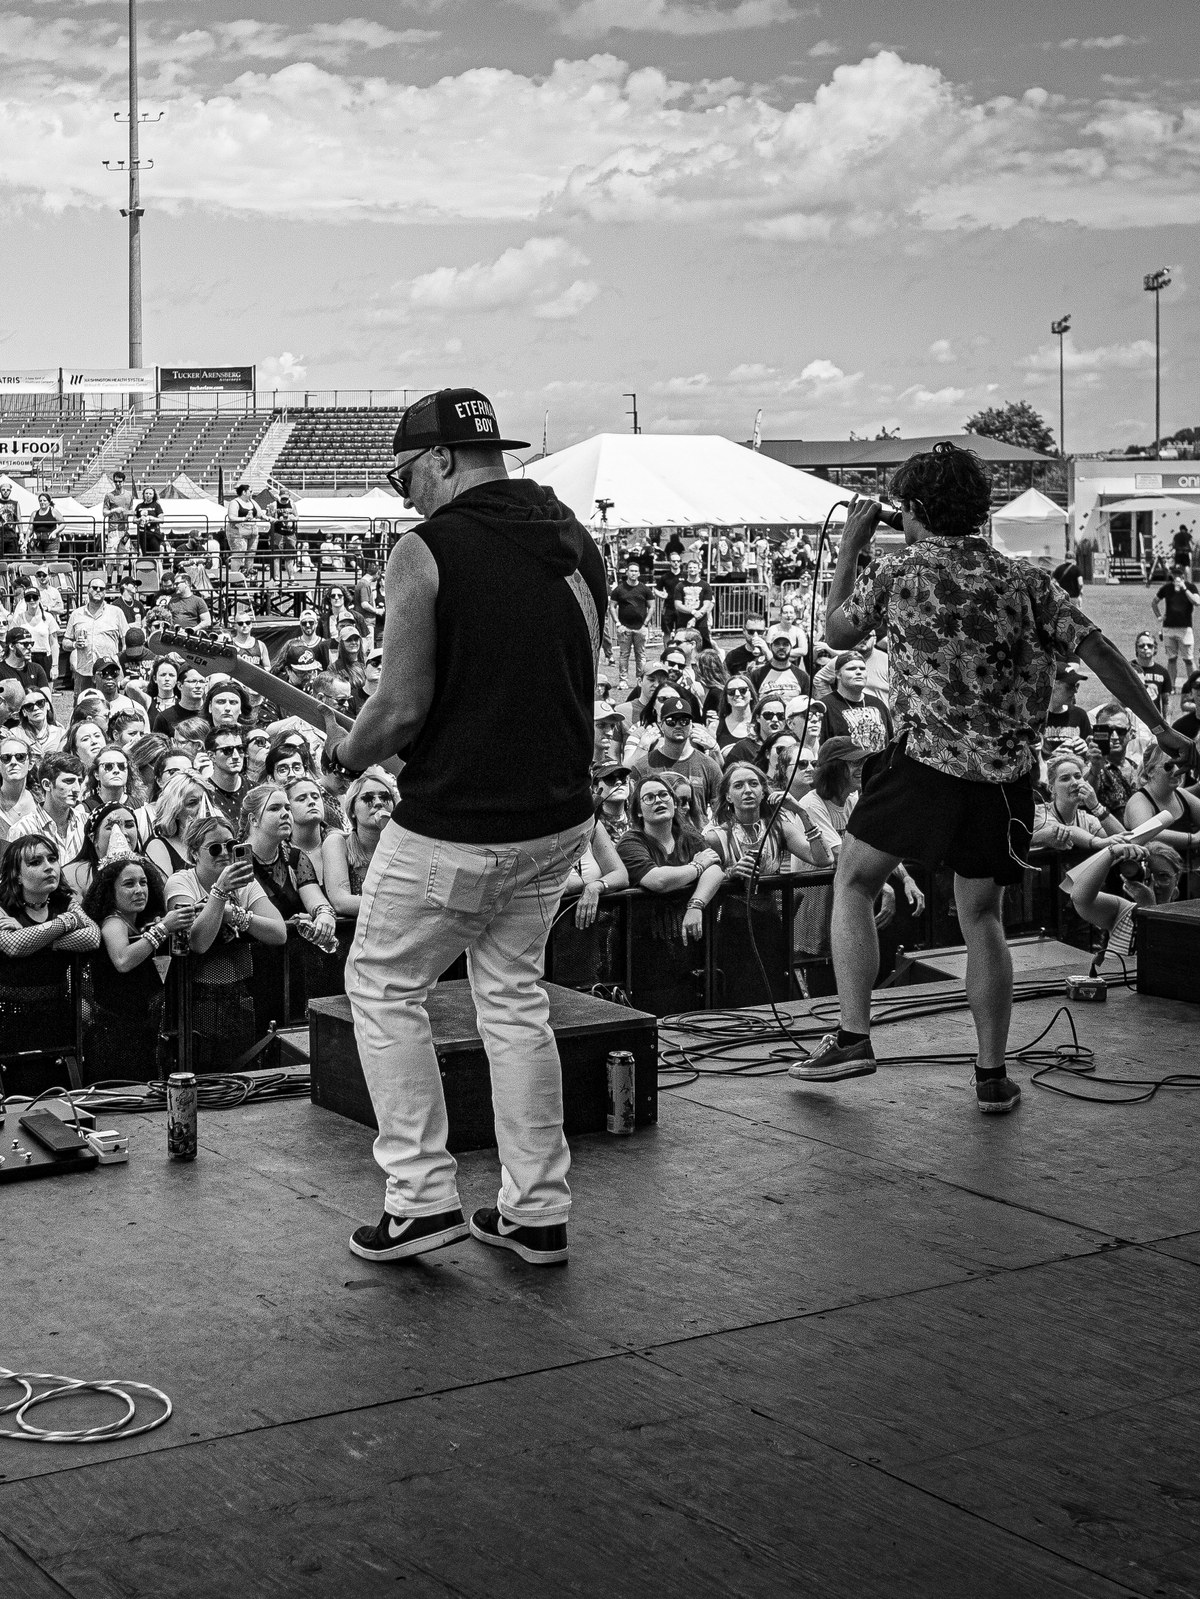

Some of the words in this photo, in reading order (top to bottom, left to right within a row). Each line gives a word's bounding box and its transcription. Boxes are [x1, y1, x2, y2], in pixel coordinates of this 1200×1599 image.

[172, 371, 200, 379] TUCKER
[474, 418, 494, 433] BOY
[22, 442, 60, 454] FOOD
